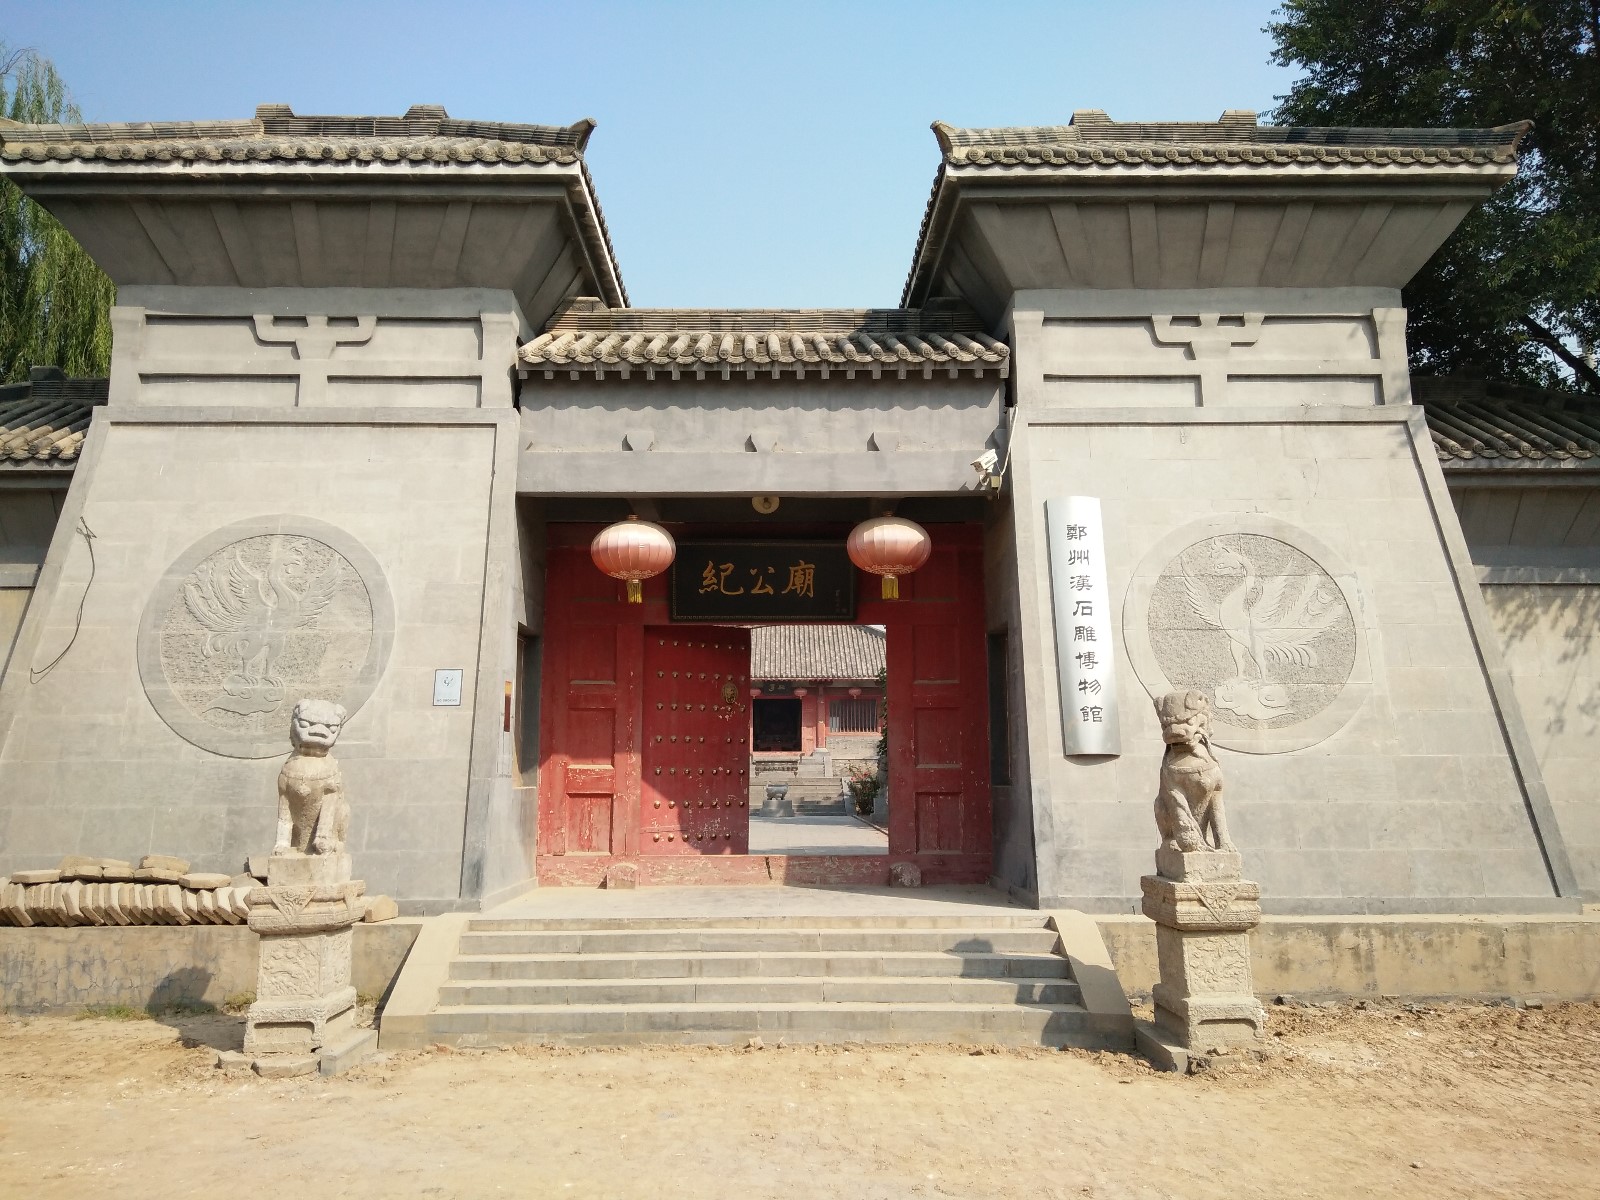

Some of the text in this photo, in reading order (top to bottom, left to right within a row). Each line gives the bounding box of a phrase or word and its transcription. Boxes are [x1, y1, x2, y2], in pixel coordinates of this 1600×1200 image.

[698, 560, 816, 598] 紀公廟
[1066, 524, 1104, 723] 鄭州漢石雕博物館
